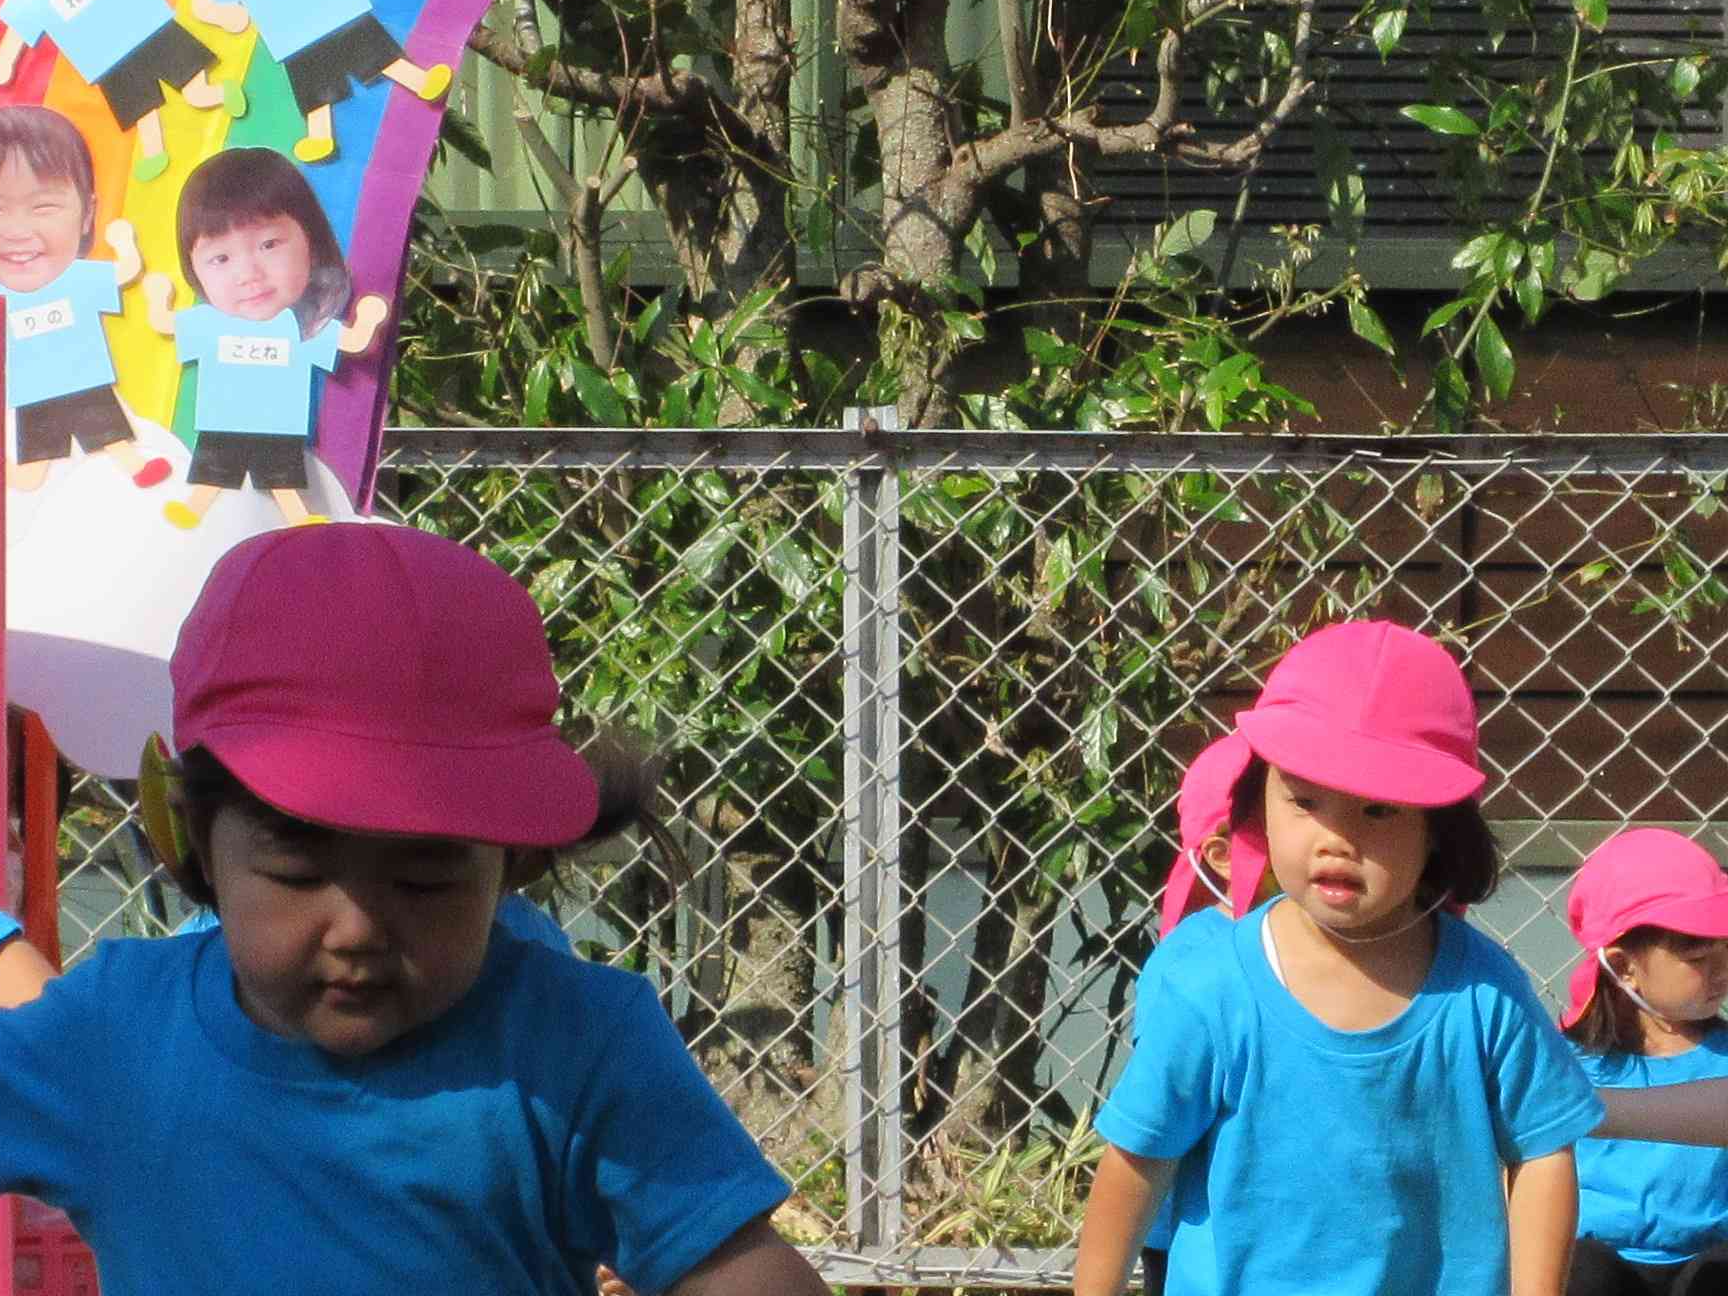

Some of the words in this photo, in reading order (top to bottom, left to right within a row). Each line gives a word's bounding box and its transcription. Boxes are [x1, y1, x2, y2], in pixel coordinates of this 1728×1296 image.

[23, 308, 63, 332] りの
[231, 343, 279, 361] ことね
